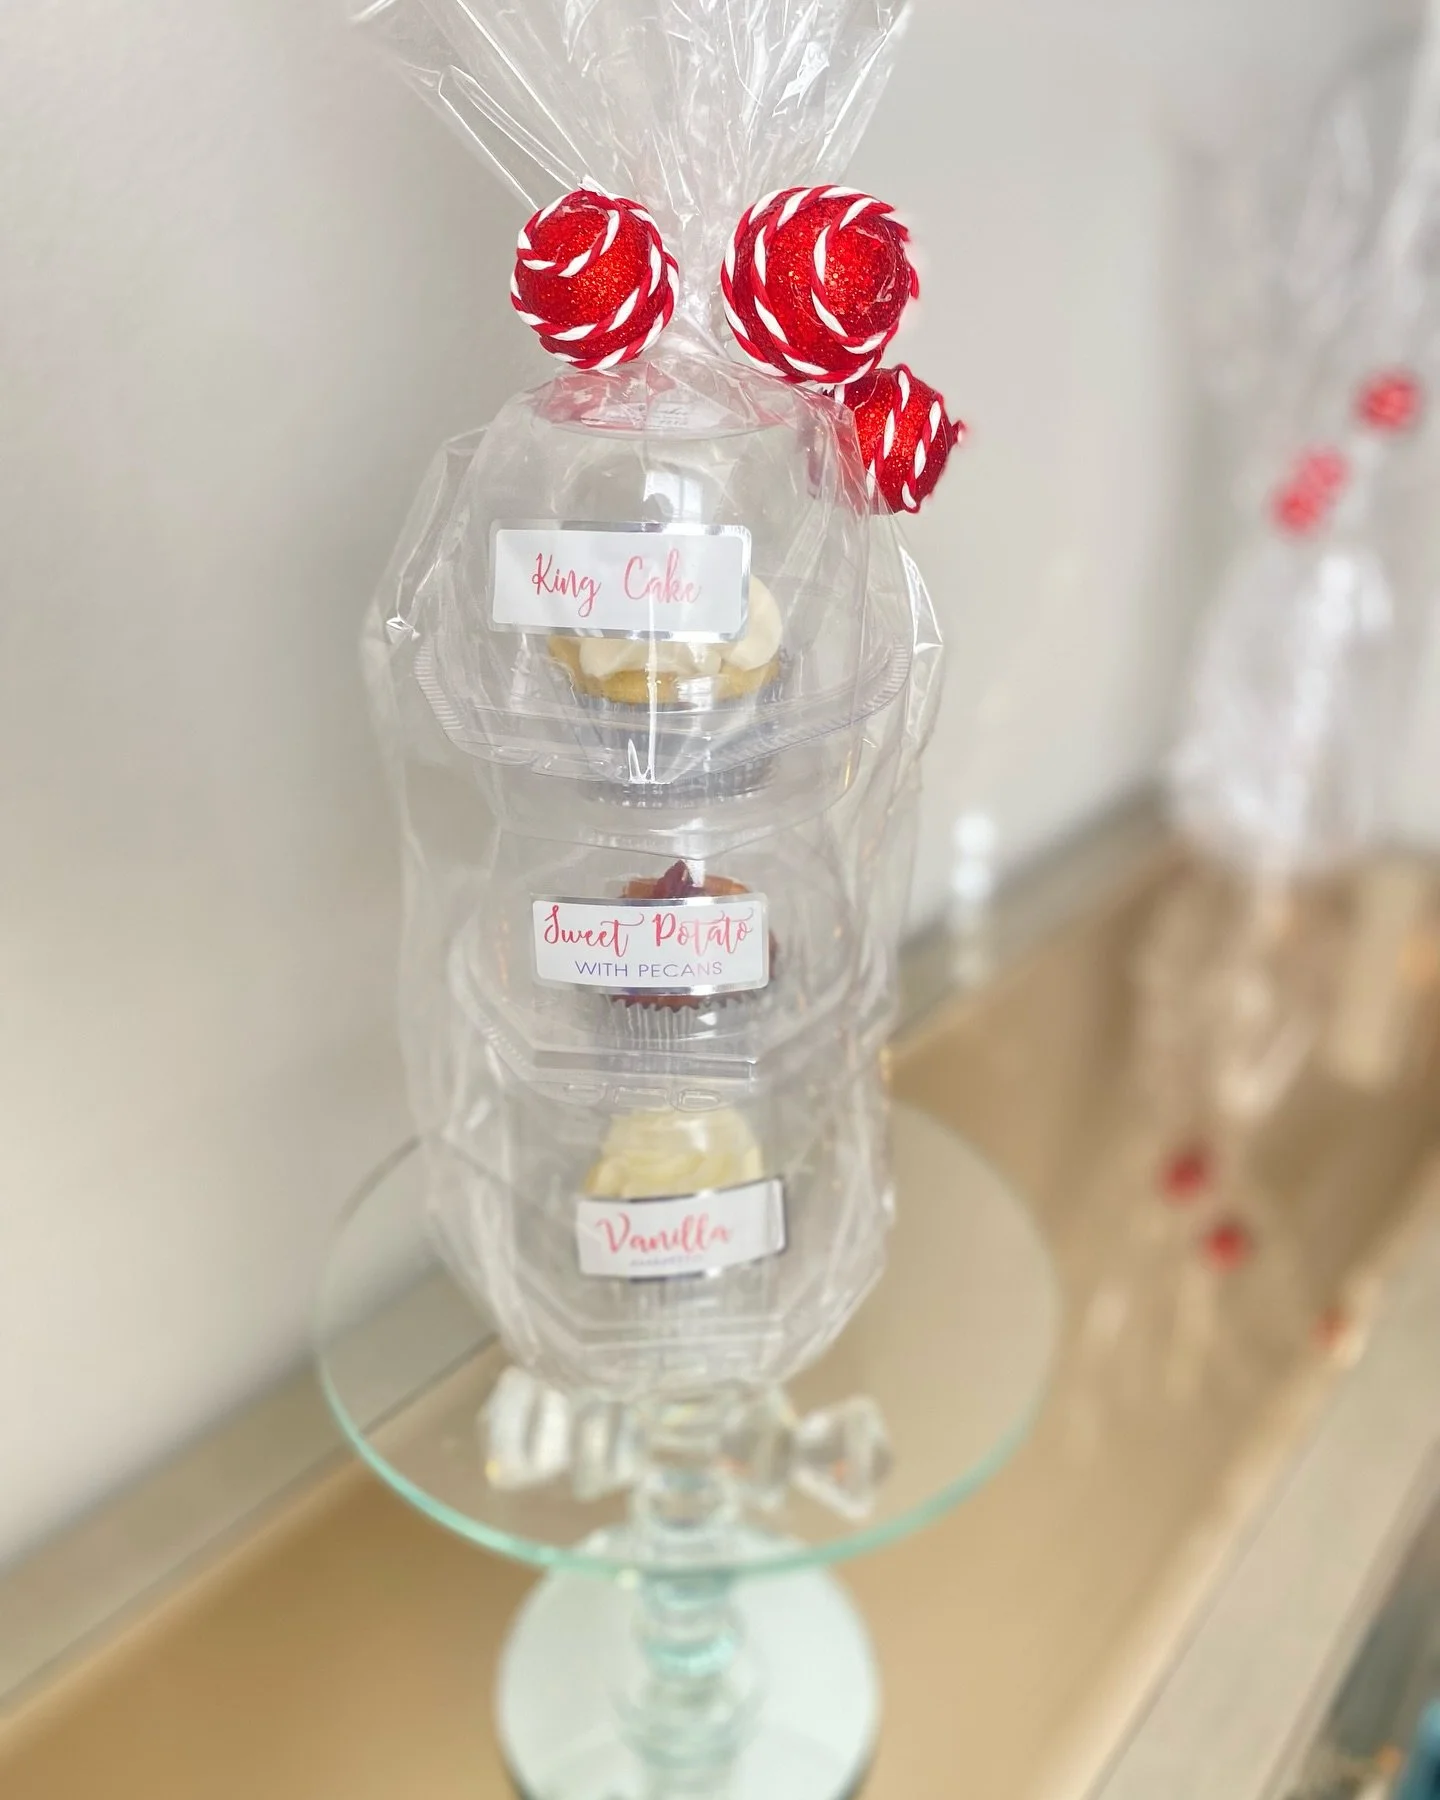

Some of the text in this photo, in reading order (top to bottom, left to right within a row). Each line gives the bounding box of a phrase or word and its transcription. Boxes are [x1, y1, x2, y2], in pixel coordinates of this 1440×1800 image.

[532, 547, 701, 617] King Cake
[544, 904, 754, 957] Sweet Potato
[575, 960, 723, 978] WITH PECANS
[596, 1211, 732, 1254] Vanilla
